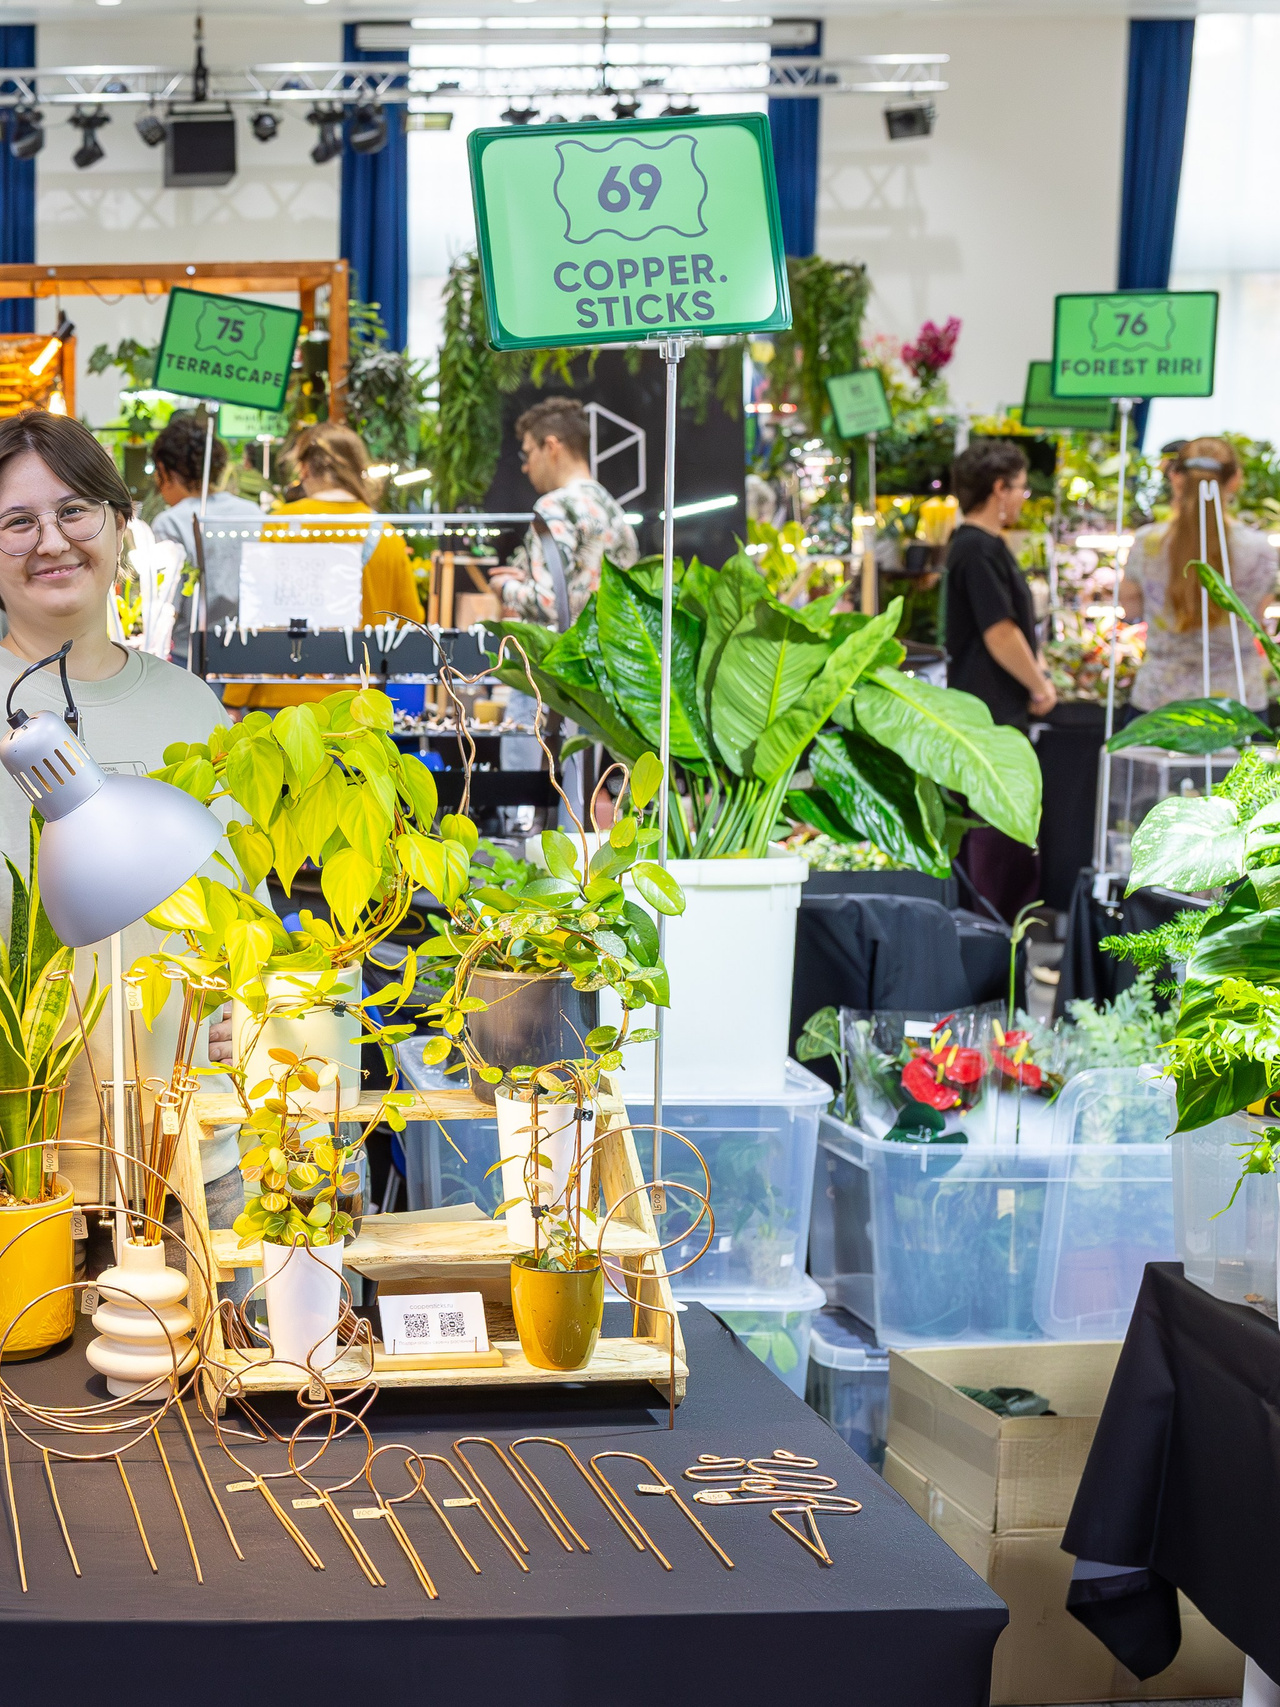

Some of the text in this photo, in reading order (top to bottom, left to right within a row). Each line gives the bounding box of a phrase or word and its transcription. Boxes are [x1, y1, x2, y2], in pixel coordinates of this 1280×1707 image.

[597, 163, 663, 214] 69
[553, 253, 728, 293] COPPER.
[576, 290, 715, 328] STICKS
[216, 316, 245, 342] 75
[1115, 313, 1148, 337] 76
[165, 353, 284, 388] TERRASCAPE
[1060, 357, 1203, 376] FOREST RIRI
[74, 1217, 84, 1235] 1200
[85, 1294, 94, 1312] 1100
